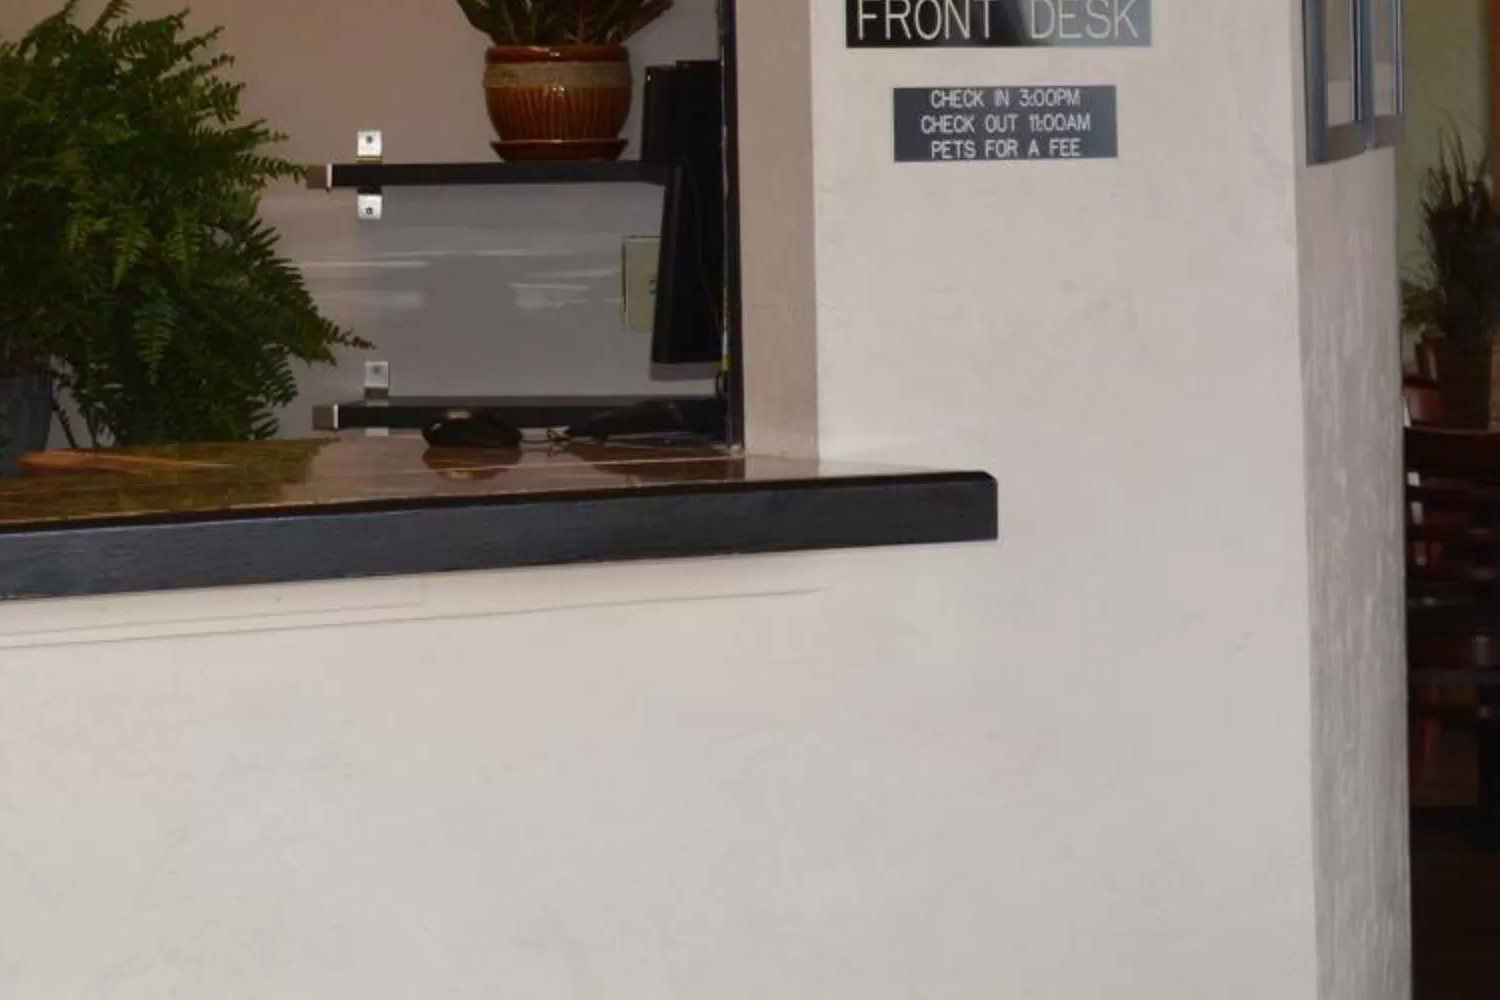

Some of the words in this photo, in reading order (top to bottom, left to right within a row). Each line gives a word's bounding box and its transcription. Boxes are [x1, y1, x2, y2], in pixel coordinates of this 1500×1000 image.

[930, 89, 985, 109] CHECK
[994, 88, 1010, 108] IN
[1019, 88, 1082, 108] 3:00PM
[920, 115, 976, 134] CHECK
[984, 114, 1019, 133] OUT
[1028, 113, 1092, 133] 11:00AM
[931, 140, 977, 160] PETS
[985, 139, 1019, 158] FOR
[1028, 139, 1041, 157] A
[1050, 138, 1082, 158] FEE
